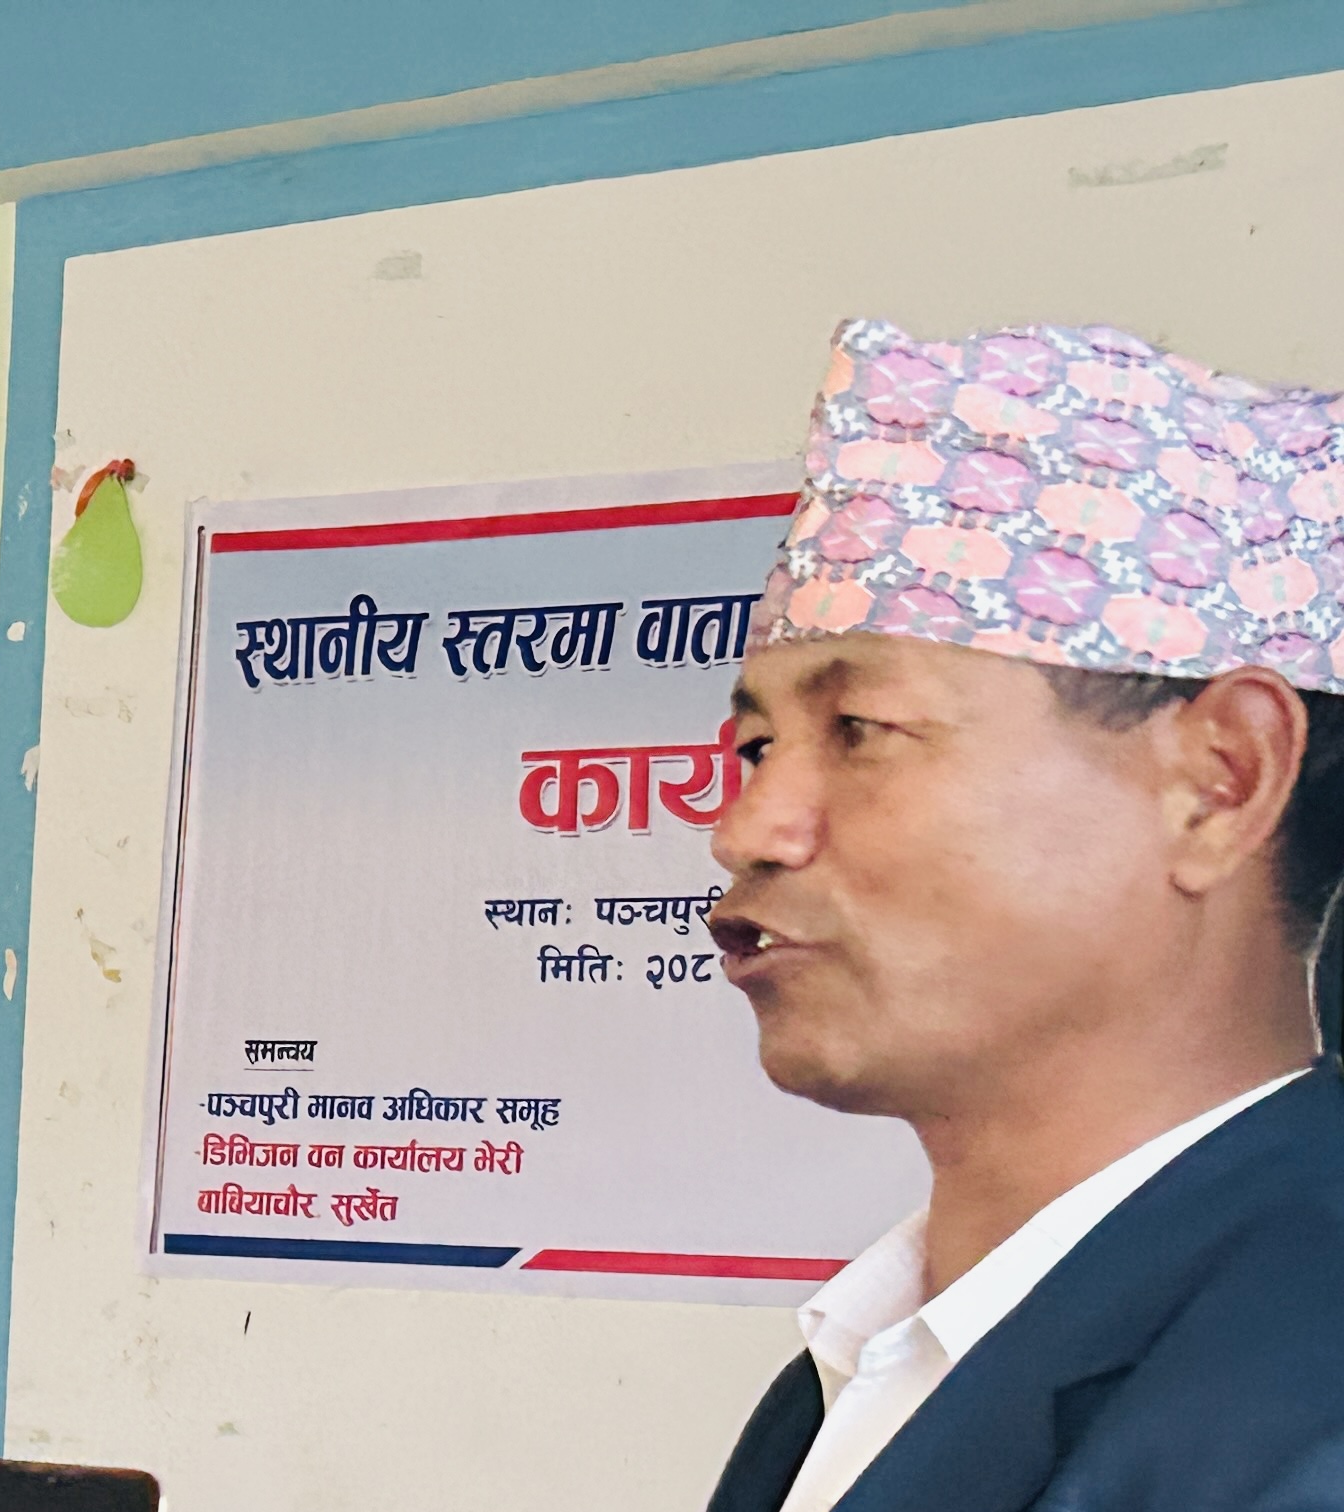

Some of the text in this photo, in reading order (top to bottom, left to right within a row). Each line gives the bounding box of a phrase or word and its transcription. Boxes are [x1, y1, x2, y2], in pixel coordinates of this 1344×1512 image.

[235, 593, 764, 690] स्थानीय स्तरमा वाता
[519, 716, 742, 832] कार्य
[646, 953, 715, 989] २०८
[244, 1039, 318, 1065] समन्वय
[307, 1094, 375, 1121] मानव
[382, 1087, 488, 1124] अधिकार
[495, 1097, 562, 1131] समूह
[307, 1144, 345, 1169] वन
[353, 1138, 467, 1173] कार्यालय
[473, 1139, 525, 1175] भेरी
[330, 1186, 399, 1227] सुर्खेत
